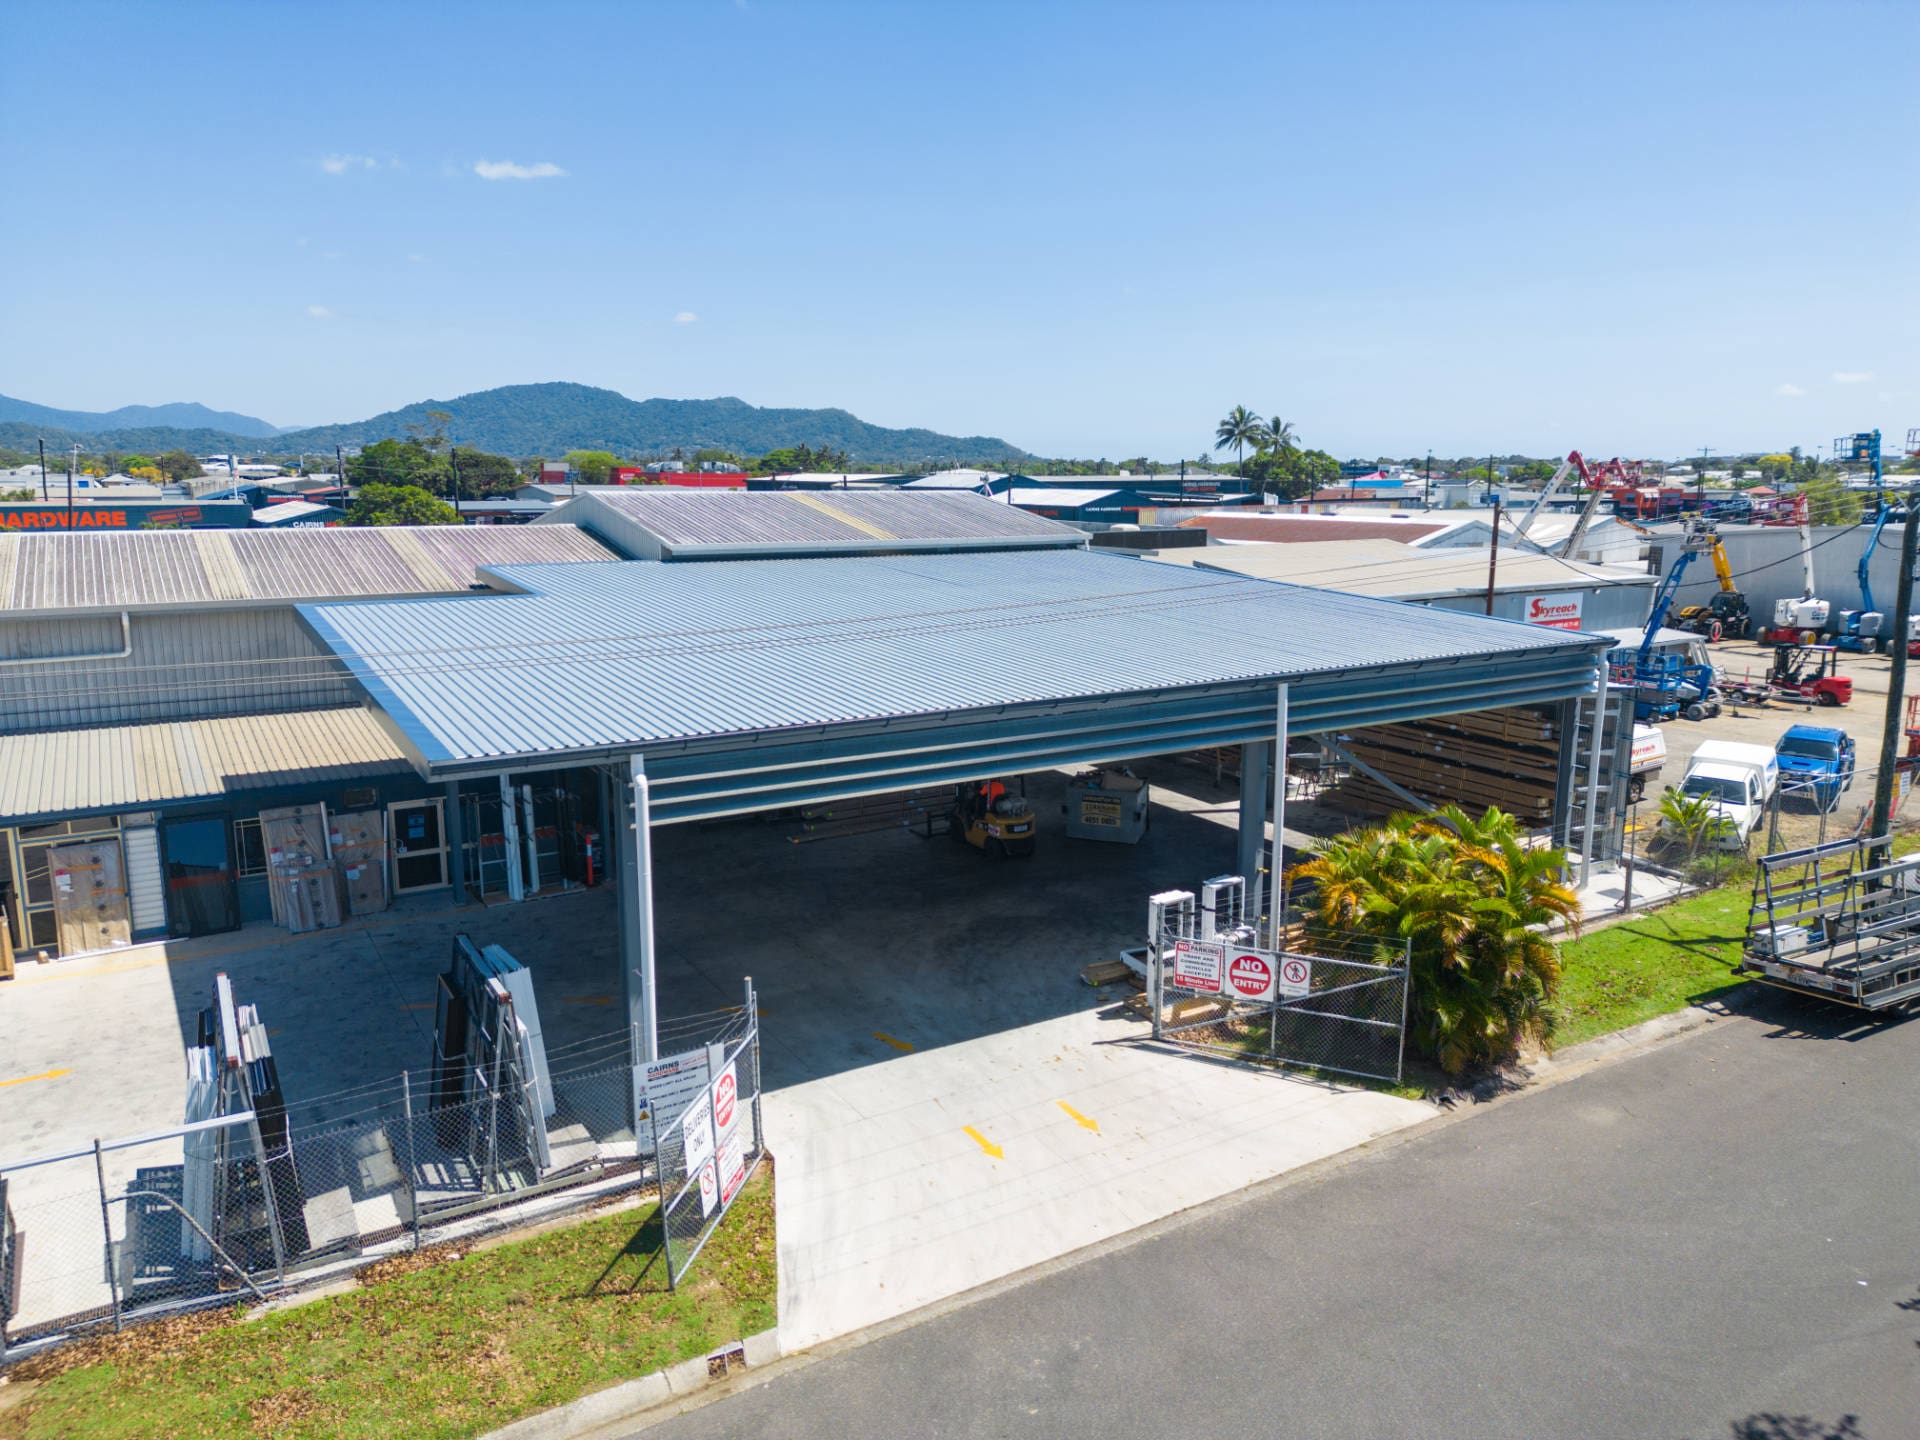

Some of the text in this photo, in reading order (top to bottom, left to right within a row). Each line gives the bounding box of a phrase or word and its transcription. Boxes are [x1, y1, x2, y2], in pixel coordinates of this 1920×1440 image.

[0, 511, 127, 527] ARDWARE
[1529, 597, 1577, 618] Skyreach
[1178, 943, 1219, 954] NO PARKING
[1239, 959, 1262, 972] NO
[1184, 976, 1204, 985] Minute
[1204, 978, 1219, 987] Limit
[1233, 978, 1267, 990] ENTRY
[647, 1060, 680, 1073] CAIRNS
[684, 1102, 710, 1139] DELIVERIES
[694, 1130, 706, 1152] ONLY
